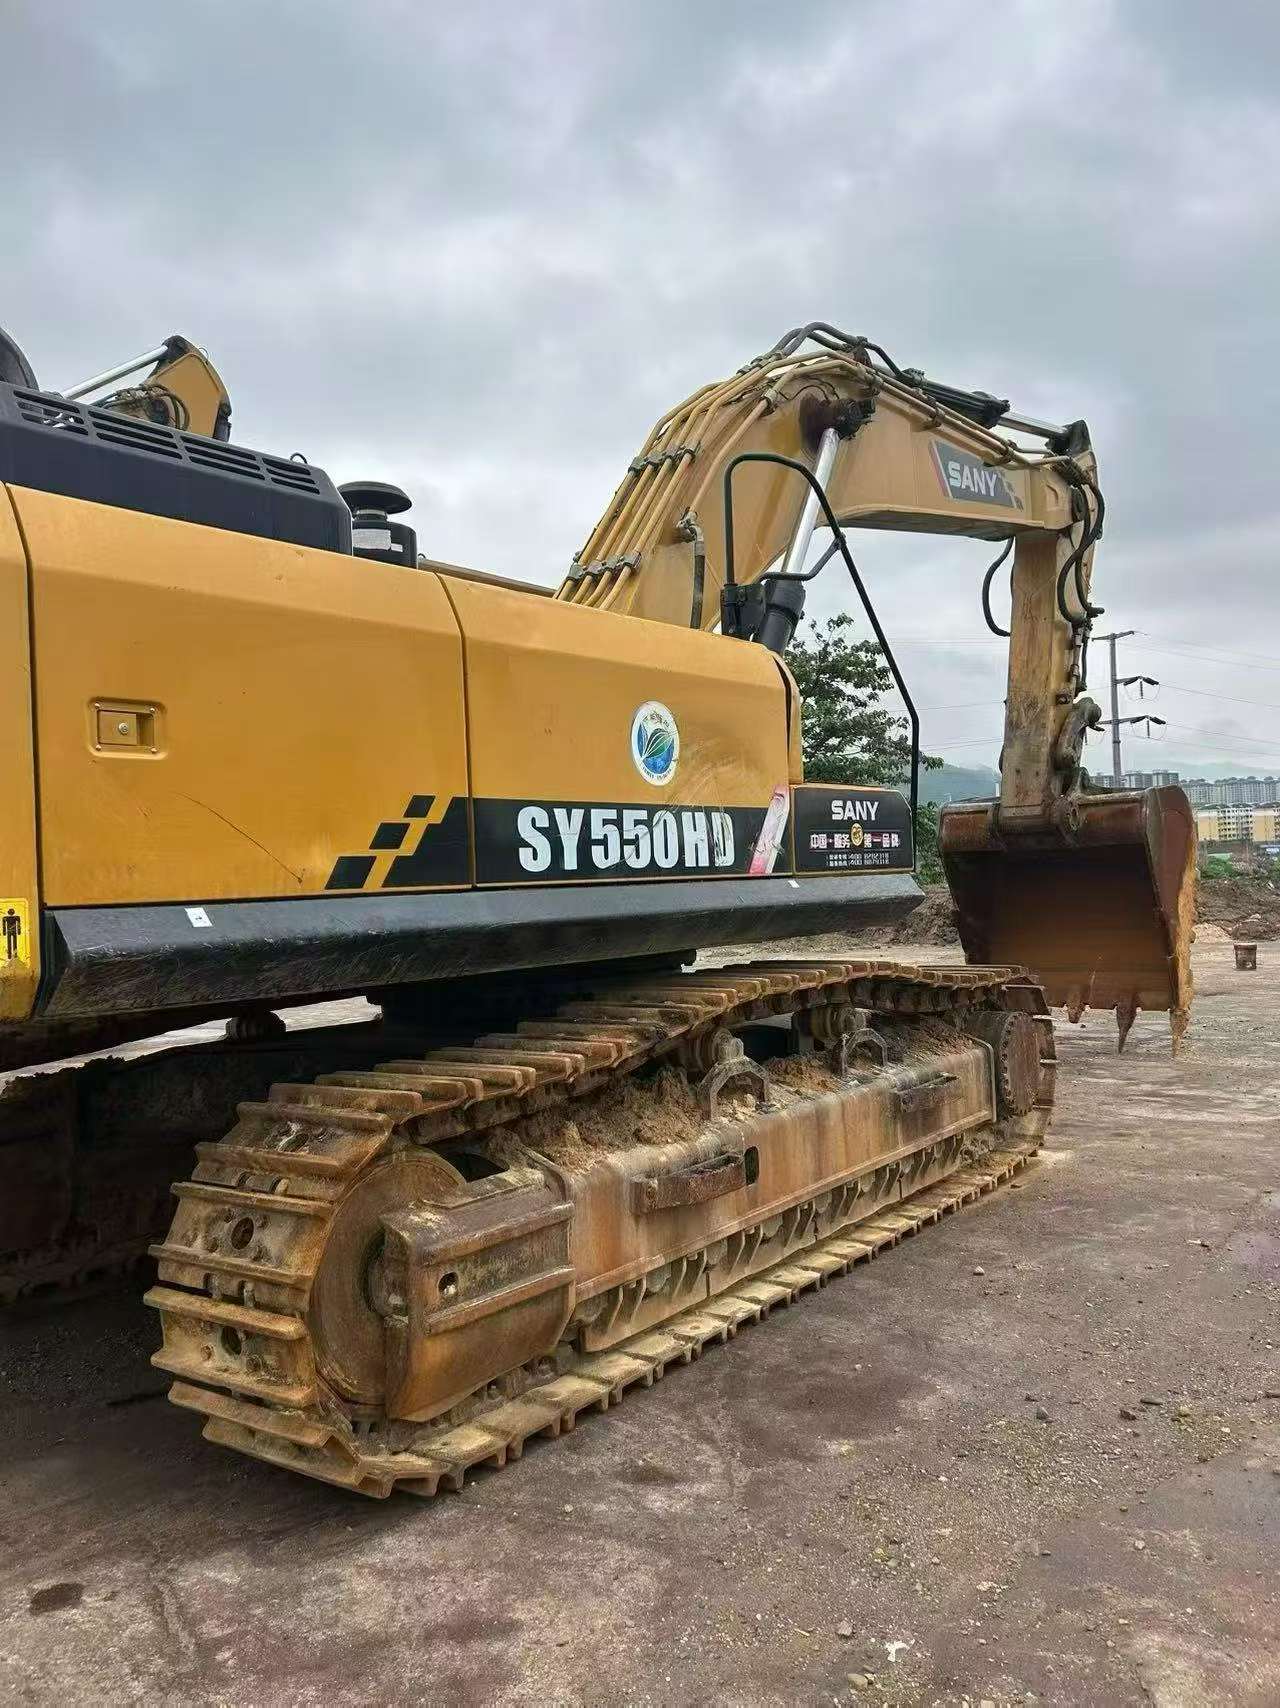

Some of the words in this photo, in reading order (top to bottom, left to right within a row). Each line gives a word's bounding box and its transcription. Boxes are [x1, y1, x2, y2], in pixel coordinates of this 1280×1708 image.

[948, 461, 997, 497] SANY
[831, 800, 879, 821] SANY
[517, 805, 735, 872] SY550HD
